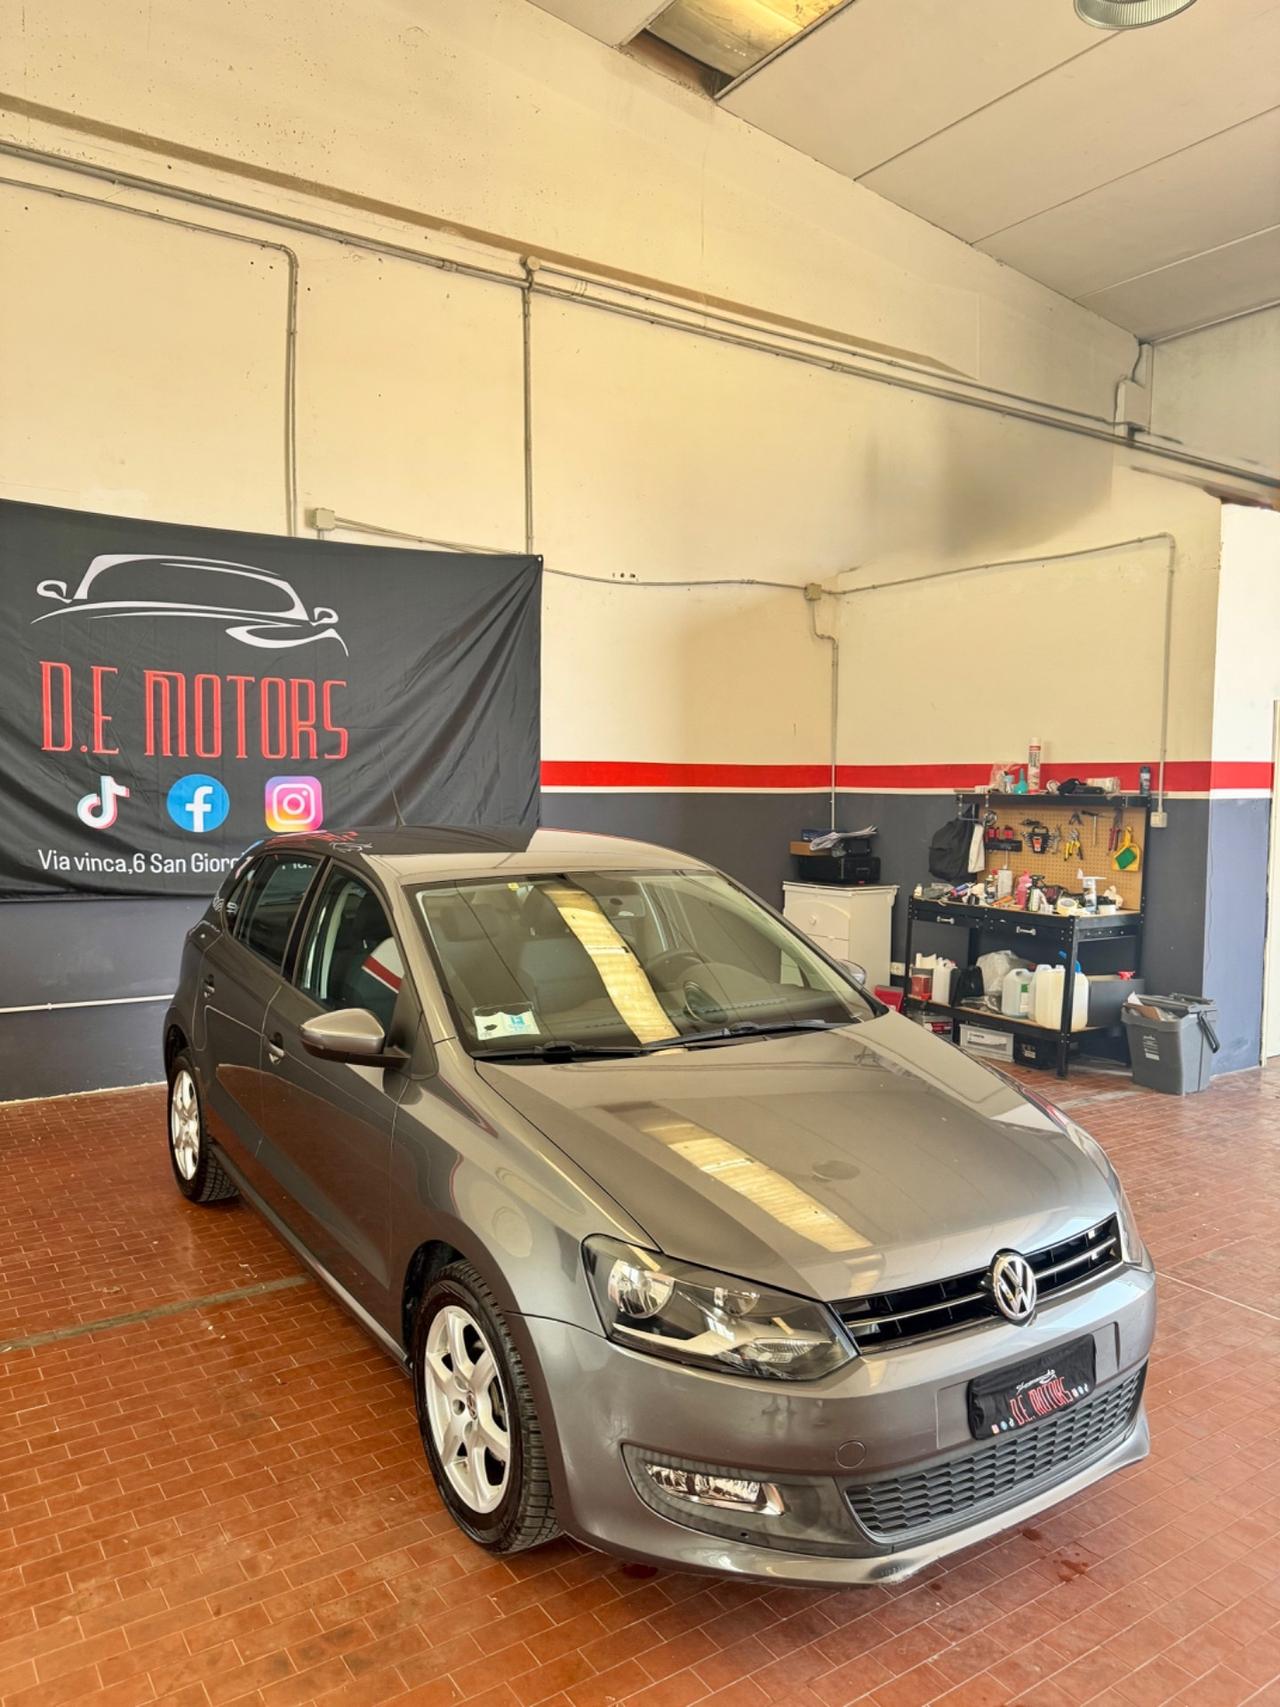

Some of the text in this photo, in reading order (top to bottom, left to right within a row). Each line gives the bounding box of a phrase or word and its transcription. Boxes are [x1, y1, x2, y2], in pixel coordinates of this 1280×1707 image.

[39, 660, 350, 760] D.E MOTORS
[38, 849, 70, 871] Via
[74, 852, 146, 875] vinca,6
[150, 853, 187, 874] San
